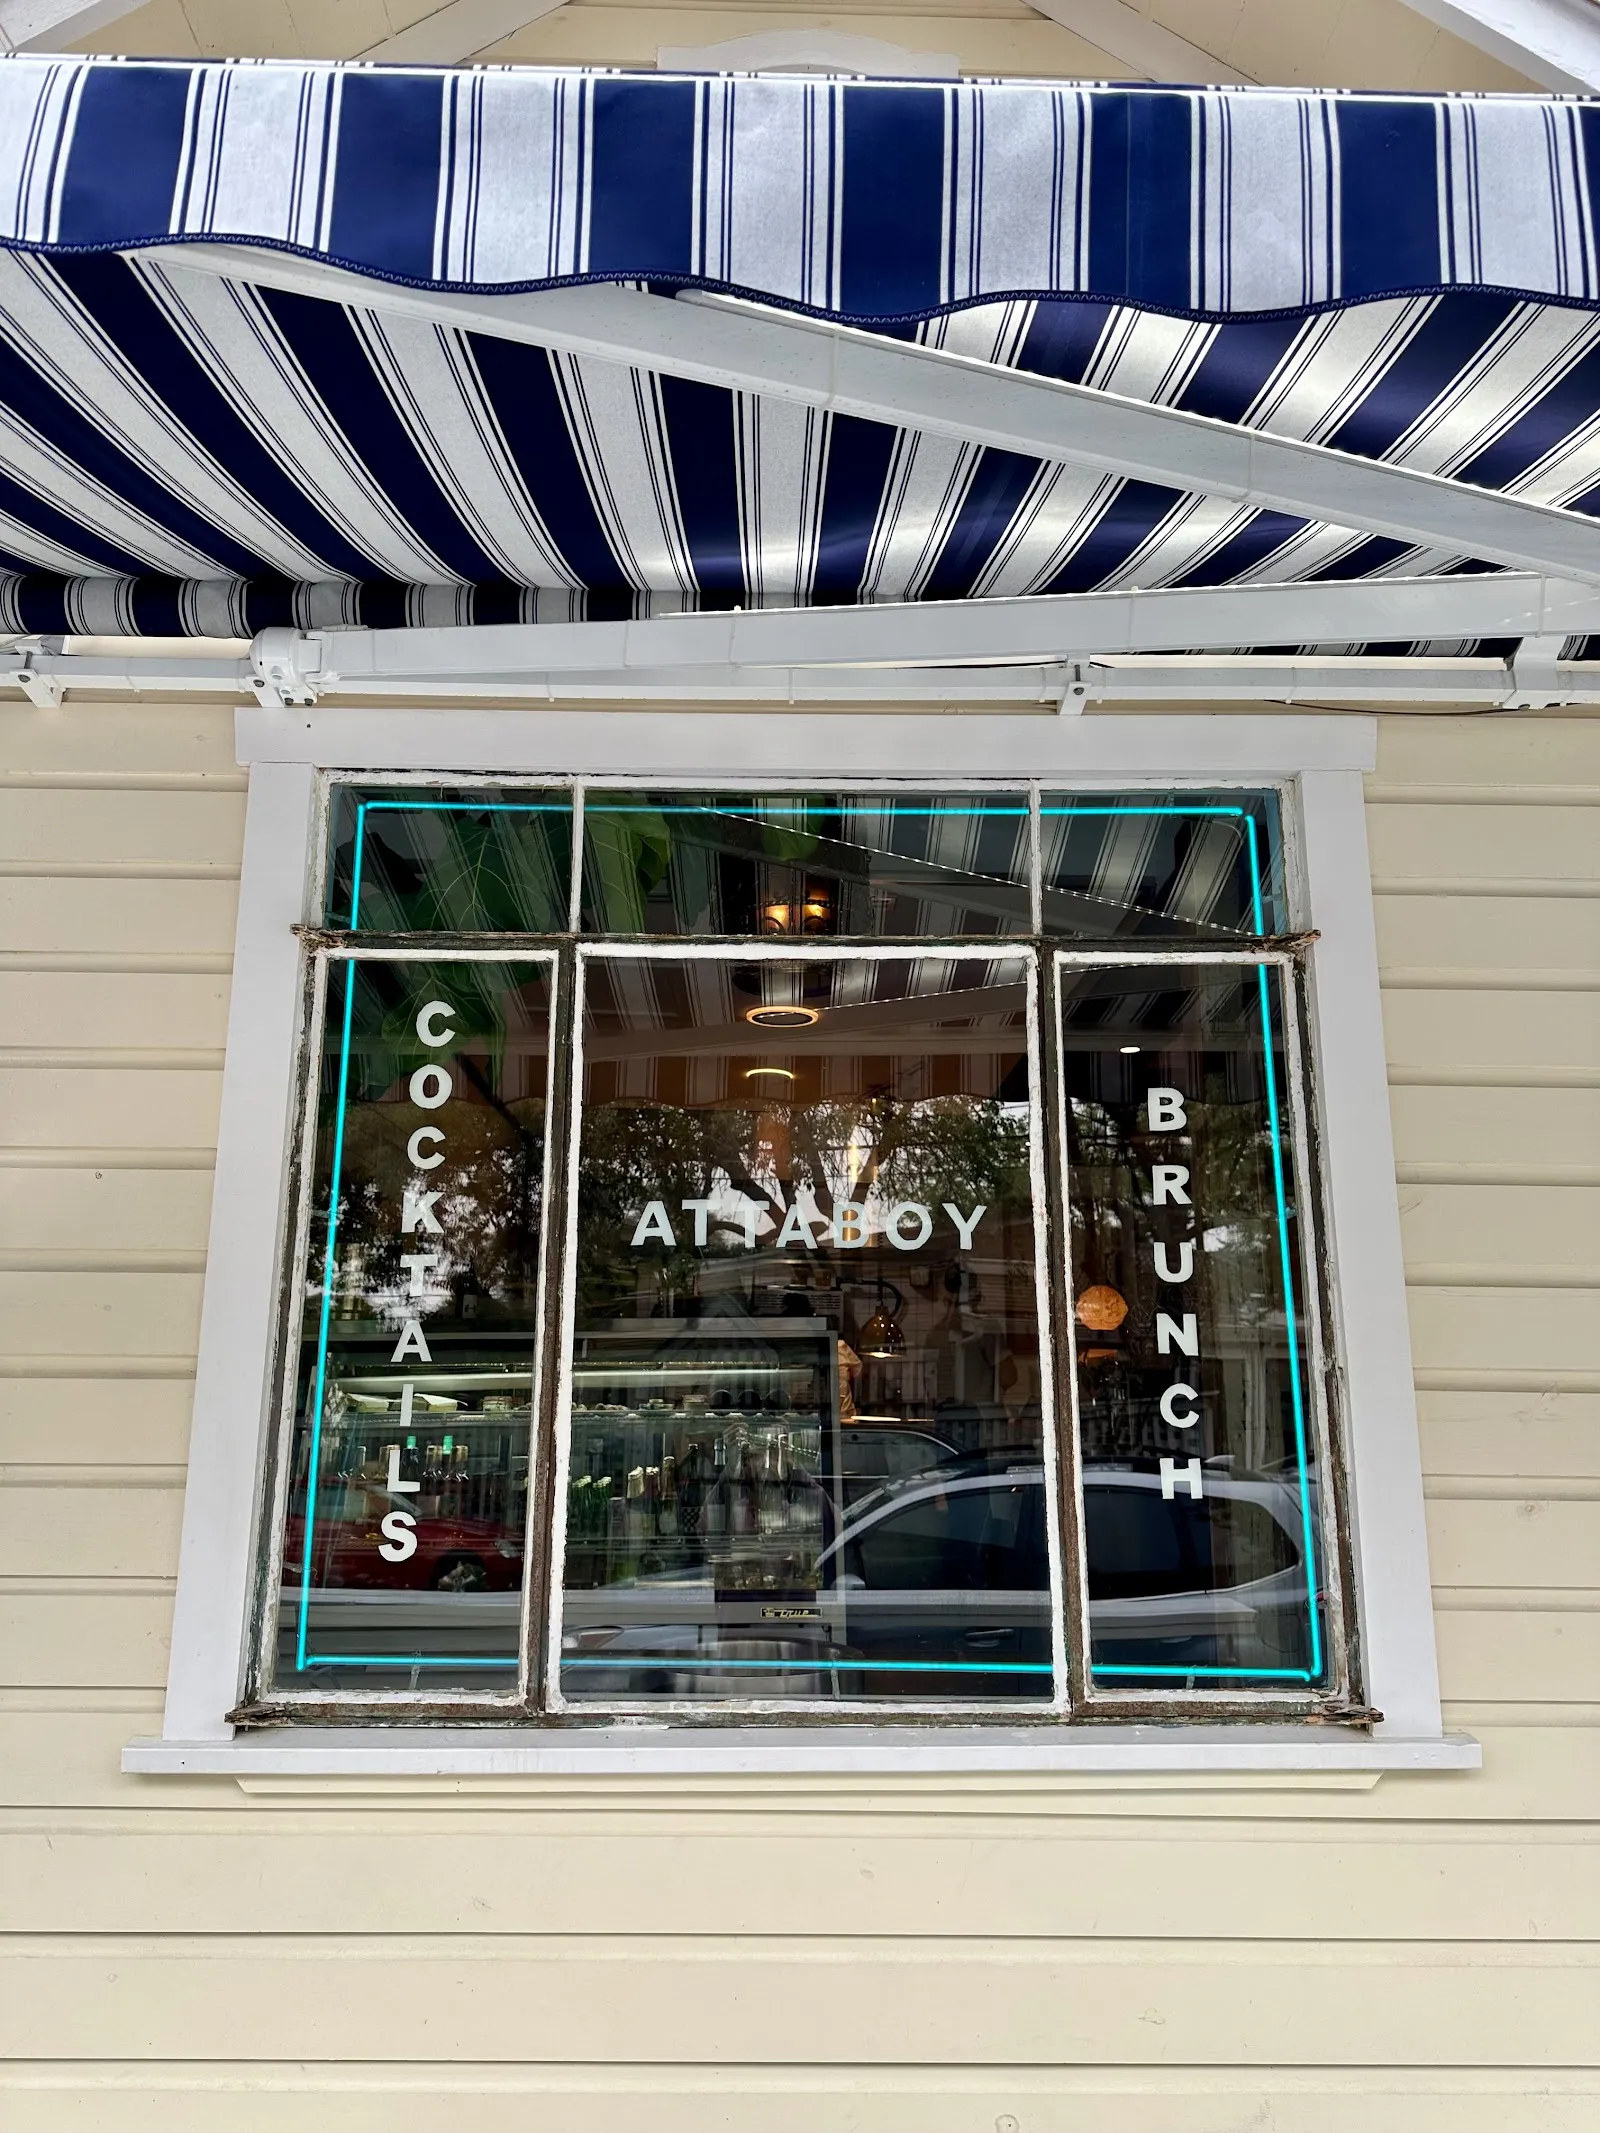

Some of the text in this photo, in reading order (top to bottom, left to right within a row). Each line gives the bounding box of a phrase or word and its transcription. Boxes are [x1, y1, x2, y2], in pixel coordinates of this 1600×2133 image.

[378, 1000, 455, 1563] COCKTAILS
[630, 1199, 988, 1251] ATTABOY
[1147, 1086, 1204, 1501] BRUNCH
